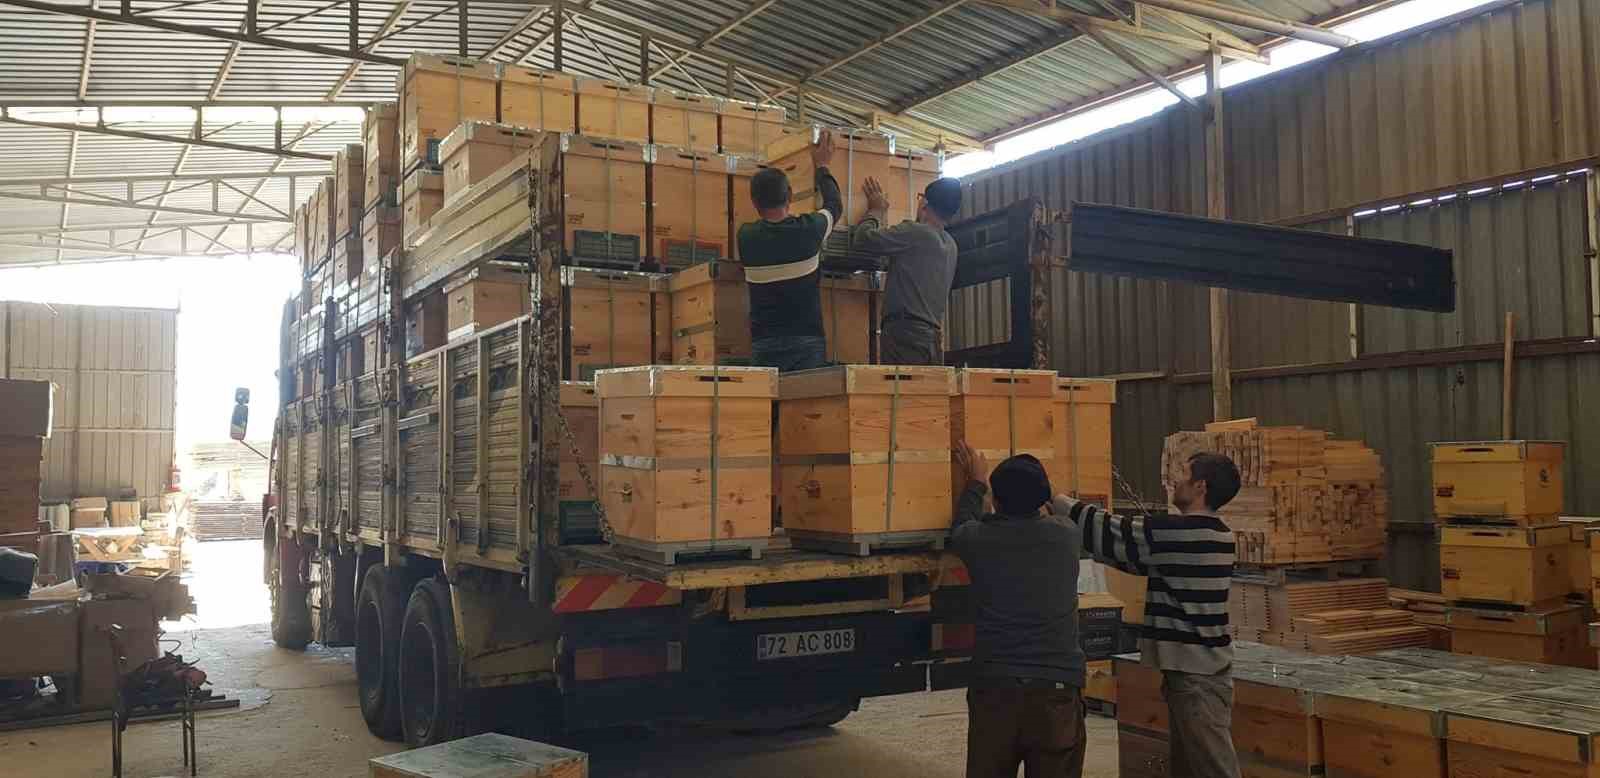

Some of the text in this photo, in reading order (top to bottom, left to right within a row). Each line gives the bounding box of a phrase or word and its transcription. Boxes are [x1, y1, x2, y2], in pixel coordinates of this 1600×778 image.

[767, 631, 852, 655] 72 AC 808
